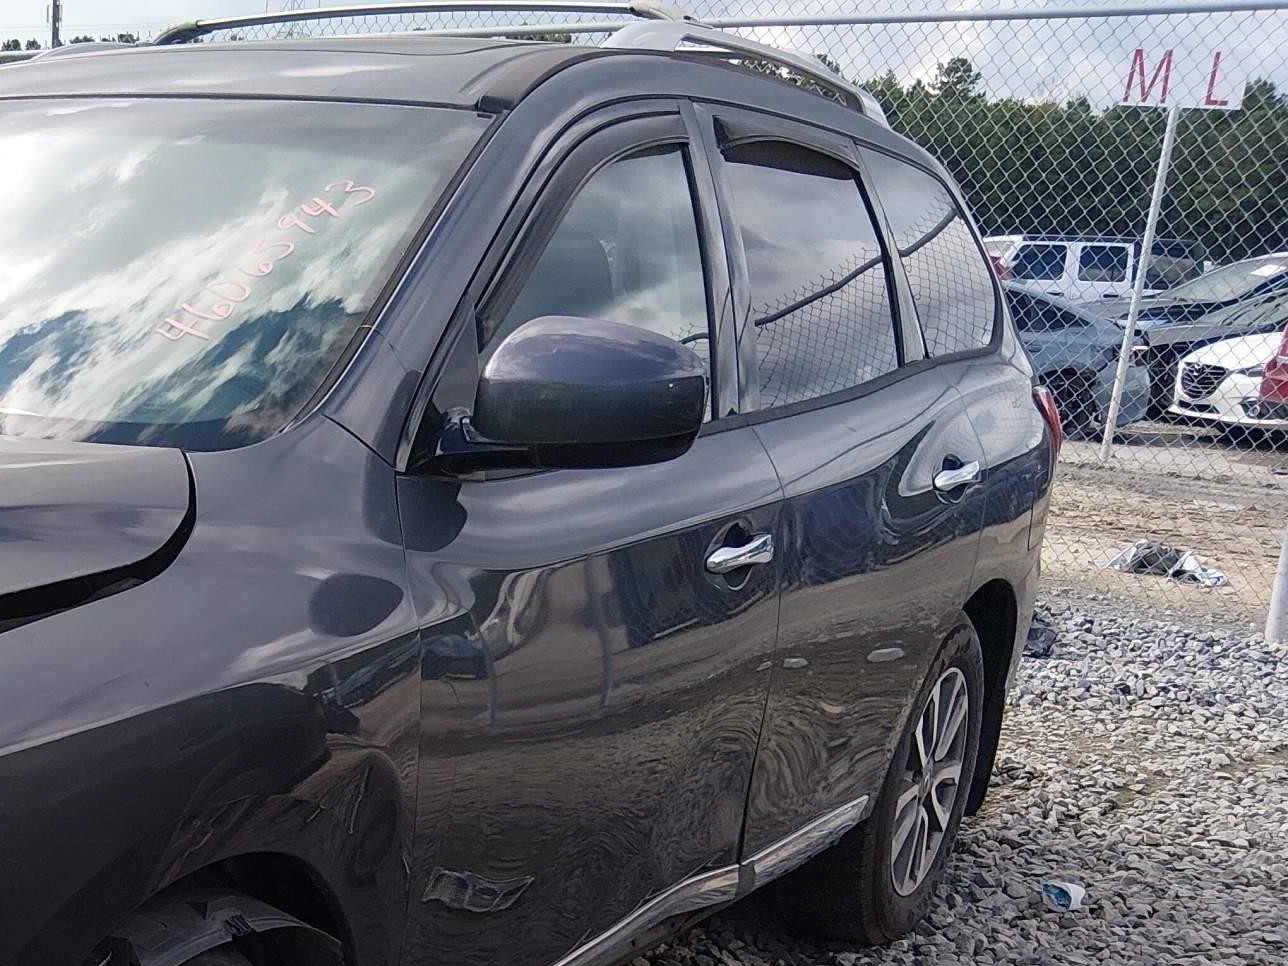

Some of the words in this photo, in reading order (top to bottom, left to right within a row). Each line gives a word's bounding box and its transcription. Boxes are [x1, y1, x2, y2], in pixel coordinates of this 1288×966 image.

[1123, 48, 1174, 104] M
[1204, 51, 1229, 106] L
[155, 179, 377, 342] 46065943
